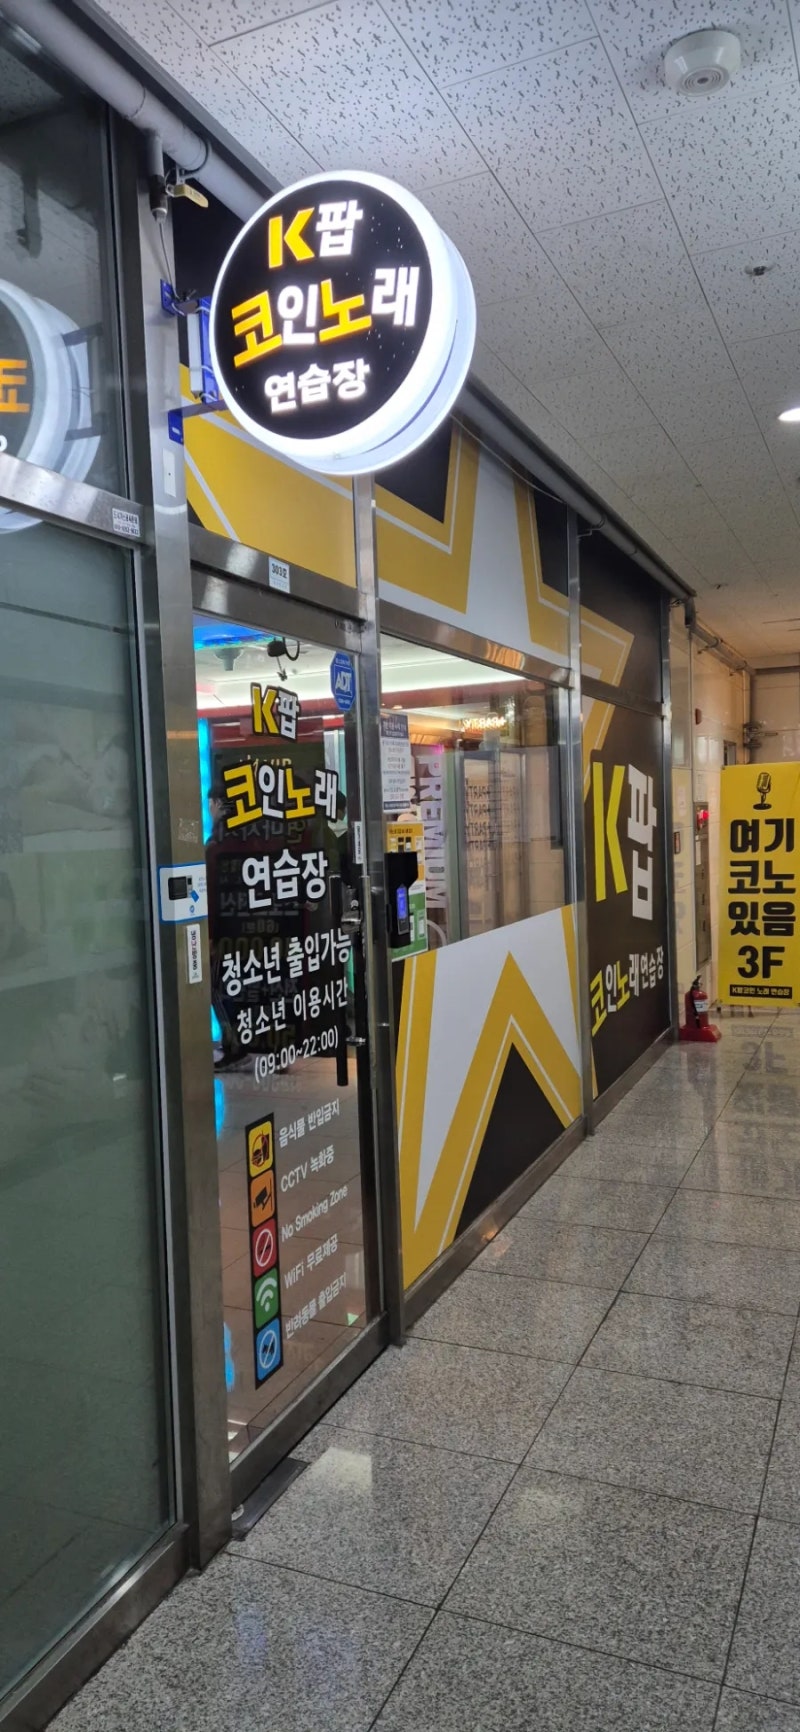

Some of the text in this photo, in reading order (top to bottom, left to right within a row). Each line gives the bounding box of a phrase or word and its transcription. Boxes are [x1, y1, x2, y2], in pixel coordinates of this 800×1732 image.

[268, 200, 363, 268] K팝
[231, 267, 420, 368] 코인노래
[264, 358, 370, 414] 연습장
[335, 671, 352, 692] ADT
[251, 685, 299, 740] K팝
[223, 763, 338, 829] 코인노래
[592, 761, 657, 921] K팝
[730, 818, 795, 853] 여기
[241, 849, 328, 909] 연습장
[728, 860, 796, 894] 코노
[728, 901, 796, 936] 있음
[222, 942, 282, 997] 청소년
[286, 928, 352, 979] 출입가능
[737, 945, 785, 979] 3F
[237, 996, 287, 1045] 청소년
[293, 977, 348, 1021] 이용시간
[255, 1025, 339, 1083] (09:00~22:00)
[279, 1098, 340, 1148] 음식물 반입금지
[281, 1144, 335, 1192] CCTV 녹화중
[281, 1185, 348, 1242] No Smoking Zone
[284, 1232, 339, 1289] WiFi 무료제공
[318, 1272, 347, 1311] 출입금지
